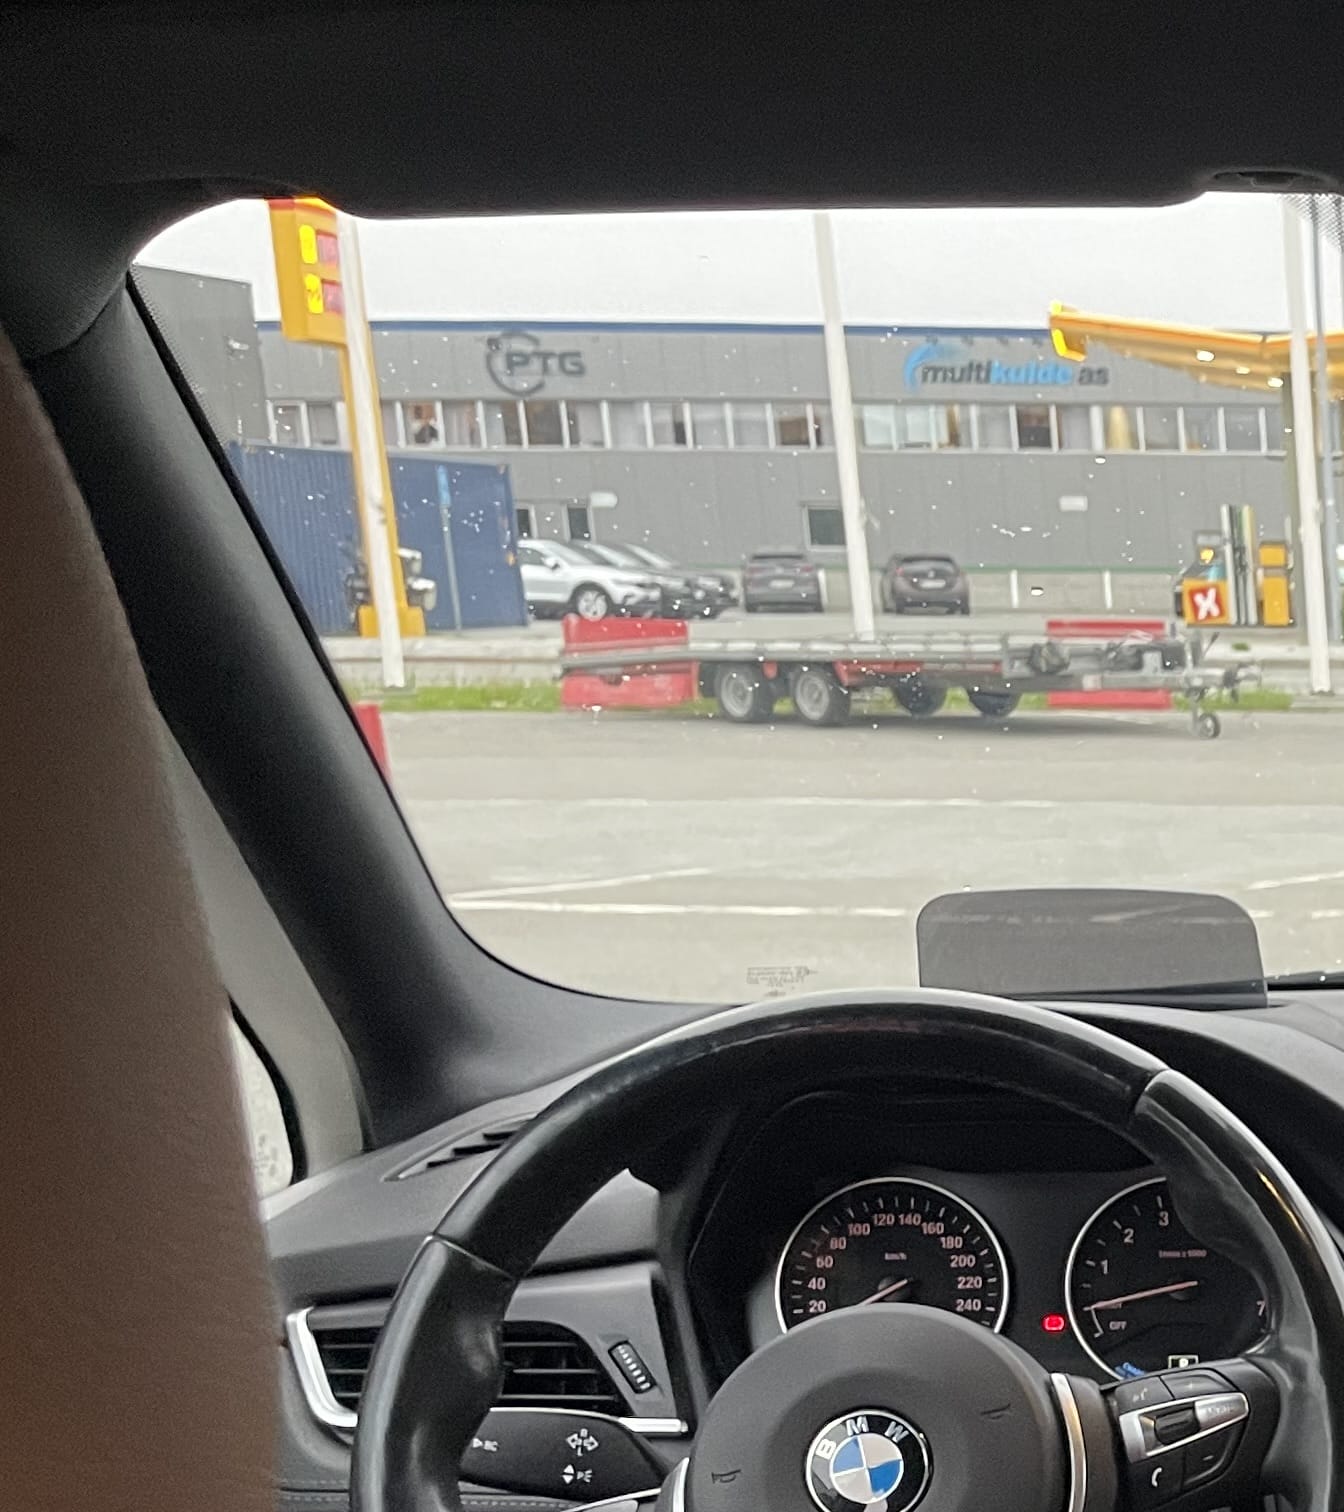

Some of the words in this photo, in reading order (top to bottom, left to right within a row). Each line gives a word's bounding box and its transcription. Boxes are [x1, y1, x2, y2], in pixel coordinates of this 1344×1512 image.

[505, 350, 587, 377] PTG
[1078, 366, 1109, 386] as
[874, 1213, 895, 1226] 120
[898, 1213, 922, 1226] 140
[1158, 1211, 1169, 1226] 3
[847, 1223, 871, 1236] 100
[921, 1222, 945, 1235] 160
[1123, 1228, 1134, 1243] 2
[830, 1237, 847, 1250] 80
[940, 1236, 963, 1249] 180
[816, 1256, 834, 1269] 60
[950, 1255, 976, 1268] 200
[1101, 1259, 1109, 1275] 1
[807, 1277, 826, 1290] 40
[957, 1276, 983, 1289] 220
[808, 1300, 827, 1313] 20
[956, 1299, 982, 1312] 240
[1256, 1300, 1266, 1316] 7
[815, 1415, 910, 1460] BMW
